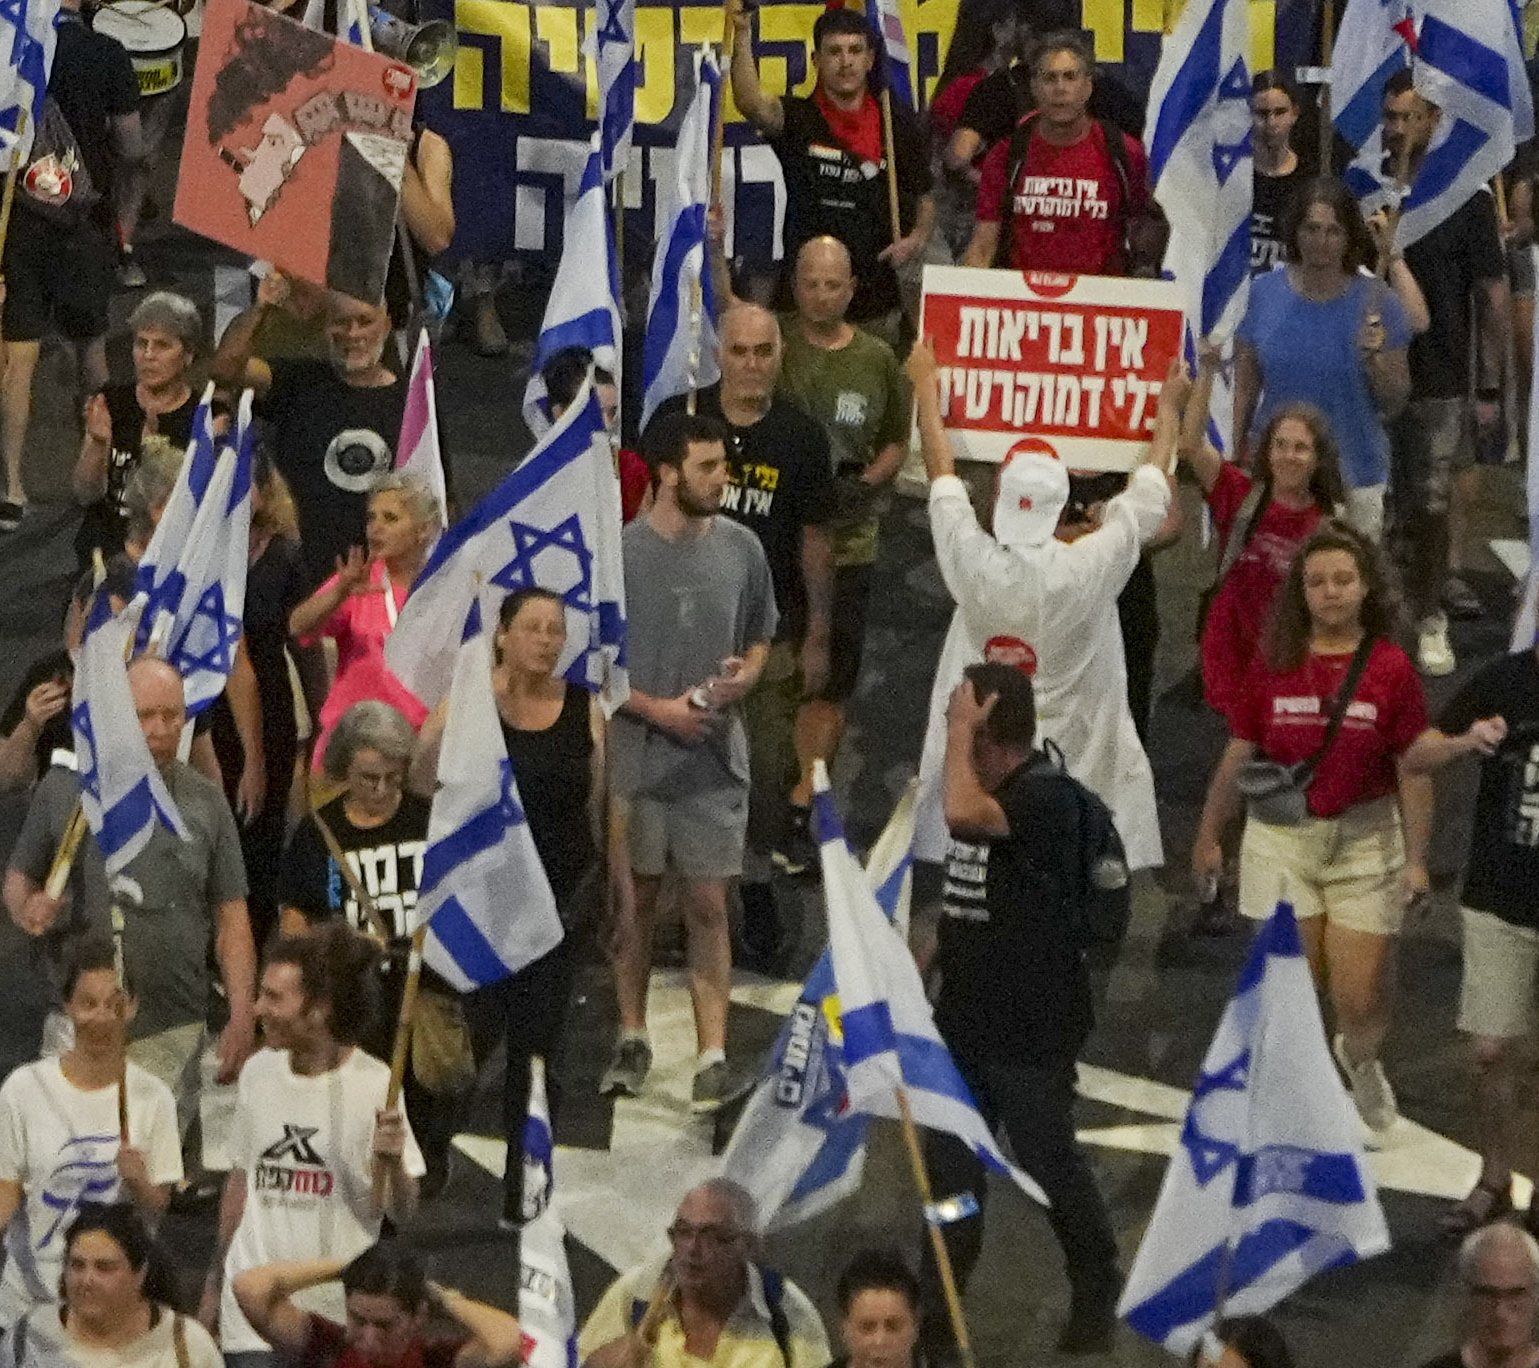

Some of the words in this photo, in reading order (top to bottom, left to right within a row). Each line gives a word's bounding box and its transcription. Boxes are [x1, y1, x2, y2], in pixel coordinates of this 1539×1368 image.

[1022, 175, 1073, 198] בריאות
[1075, 178, 1100, 200] אין
[1083, 200, 1109, 220] בלי
[955, 305, 1085, 367] בריאות
[1094, 316, 1149, 372] אין
